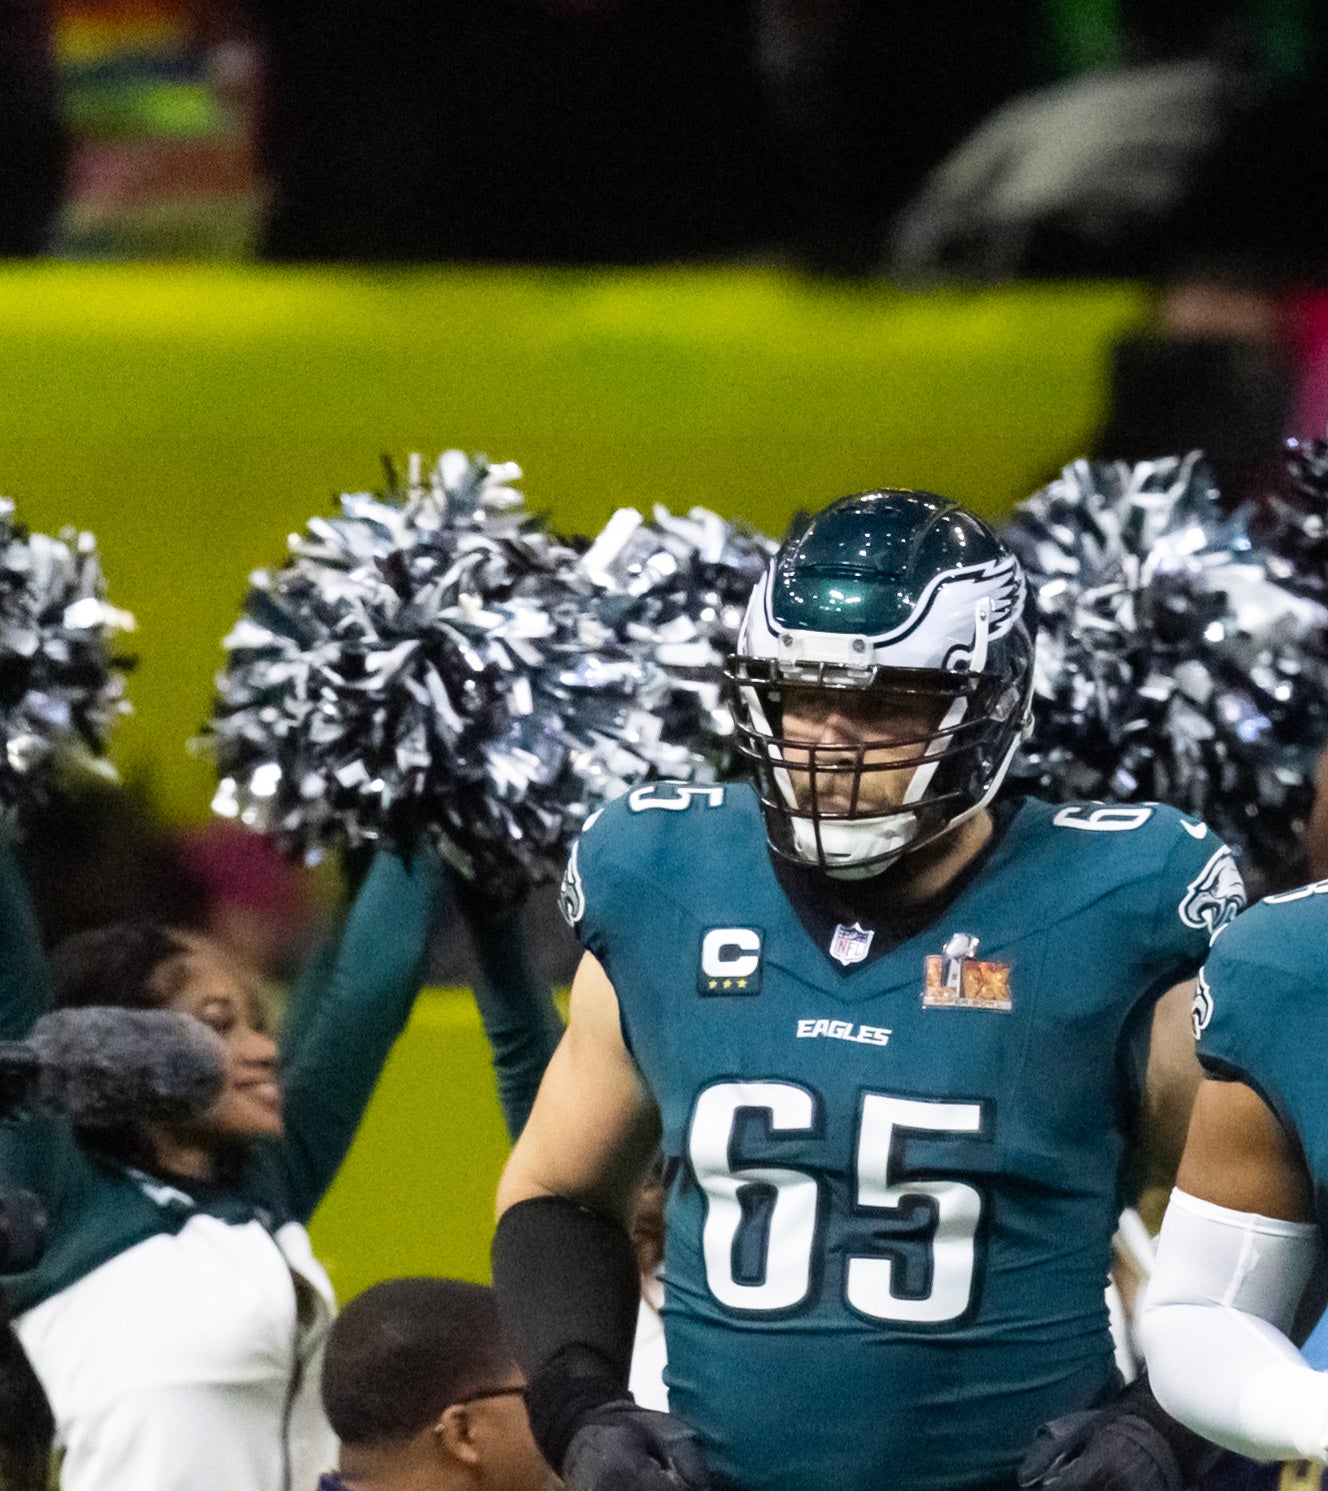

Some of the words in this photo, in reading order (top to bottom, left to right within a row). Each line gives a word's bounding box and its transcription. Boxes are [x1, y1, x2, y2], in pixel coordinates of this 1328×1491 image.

[701, 928, 761, 978] C
[796, 1019, 893, 1046] EAGLES
[689, 1081, 982, 1323] 65
